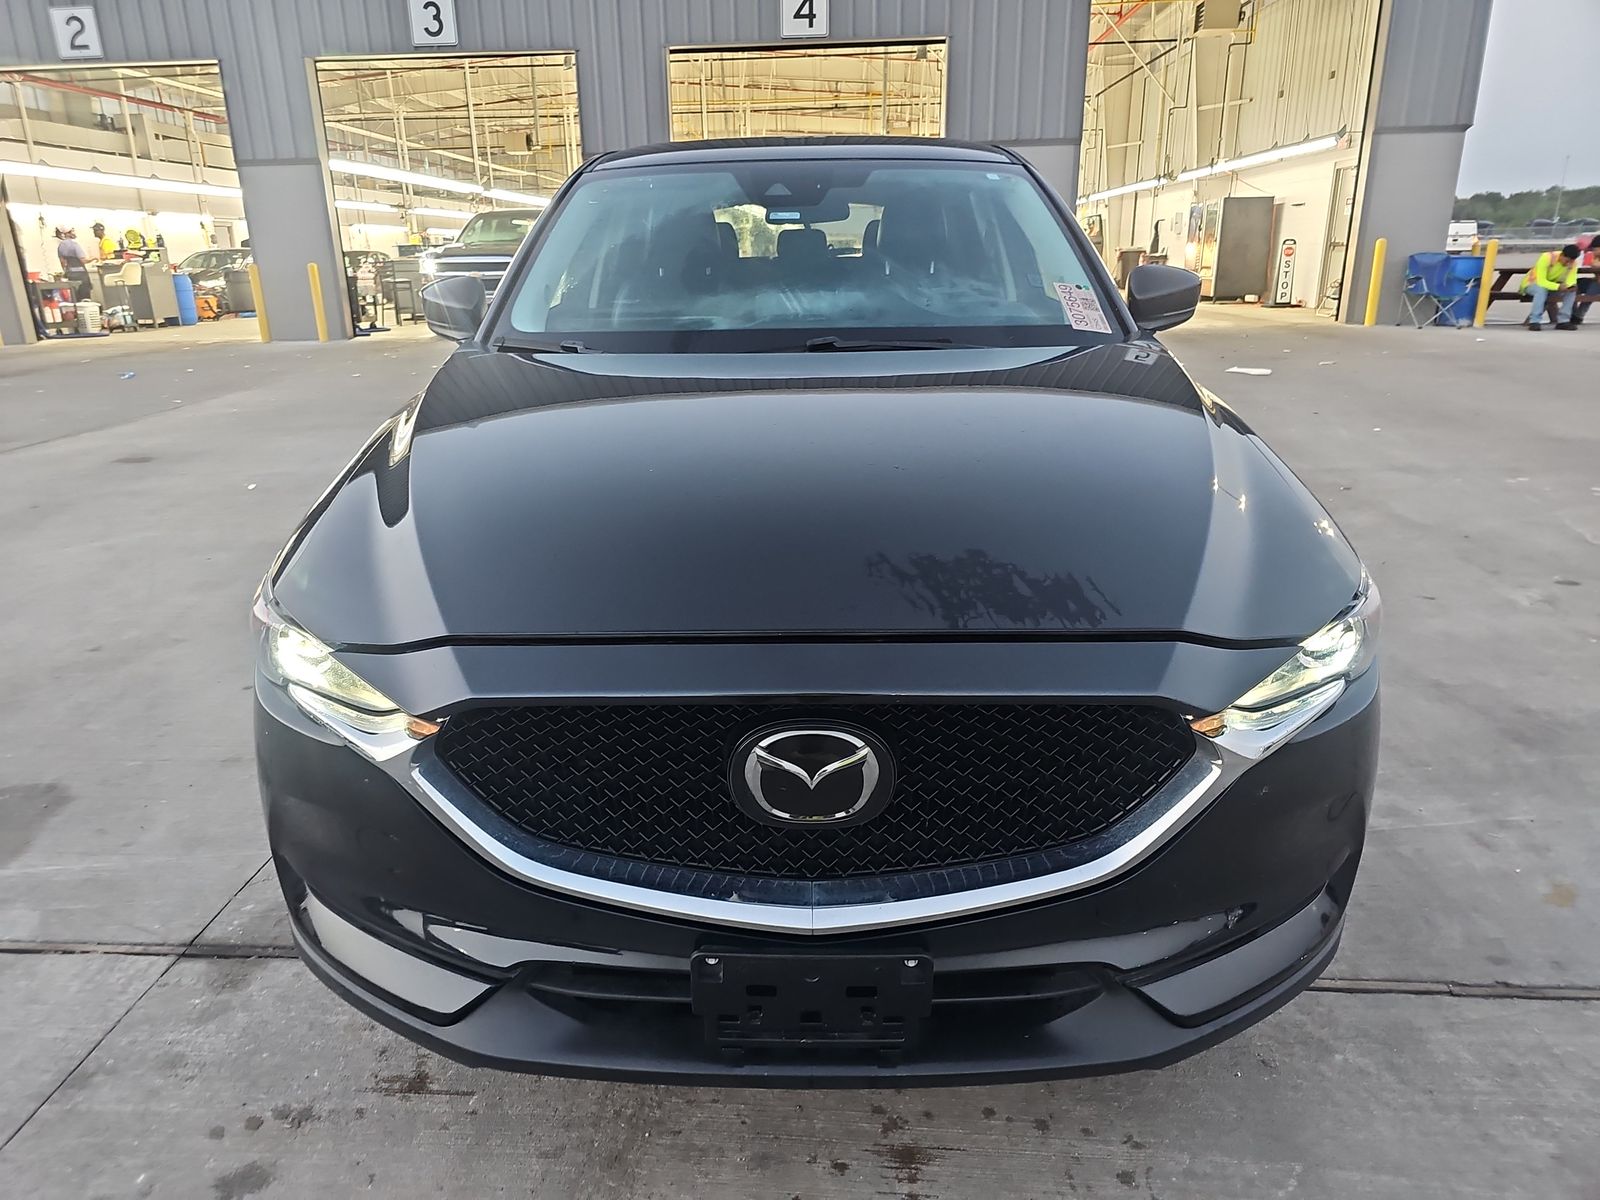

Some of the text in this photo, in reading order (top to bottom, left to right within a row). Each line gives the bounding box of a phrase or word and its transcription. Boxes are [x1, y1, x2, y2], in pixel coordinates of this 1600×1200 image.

[423, 1, 443, 37] 3
[793, 0, 816, 28] 4
[66, 16, 90, 50] 2
[1280, 260, 1291, 300] STOP
[1058, 284, 1088, 326] 3075649
